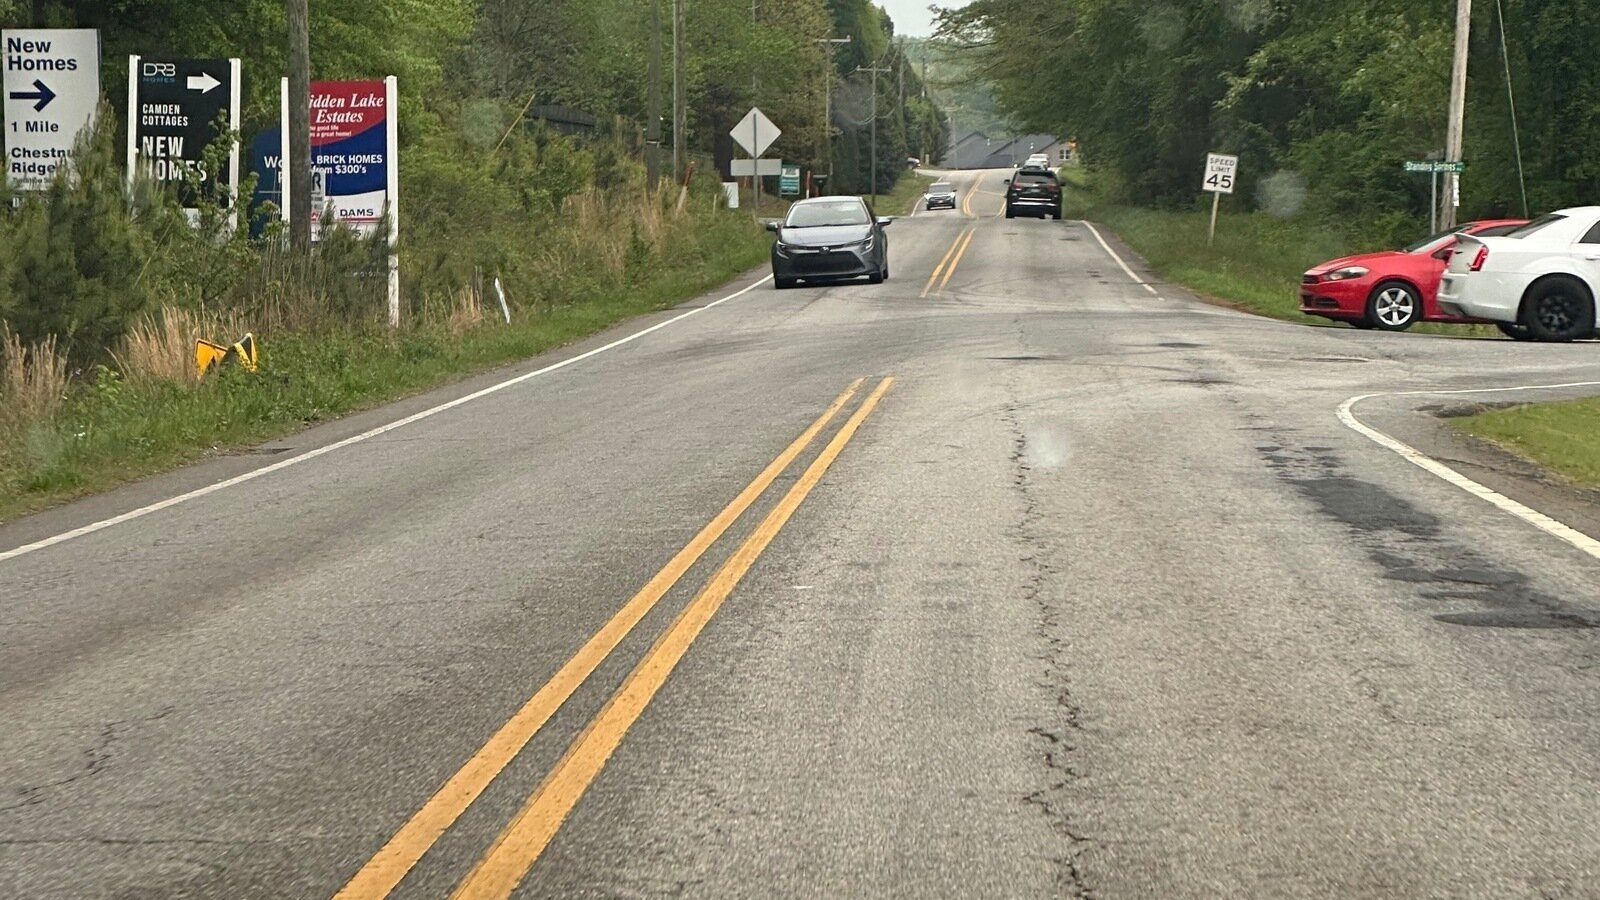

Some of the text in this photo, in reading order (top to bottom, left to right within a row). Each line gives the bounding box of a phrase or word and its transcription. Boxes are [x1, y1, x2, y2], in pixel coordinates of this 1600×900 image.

[7, 37, 51, 53] New
[8, 55, 77, 71] Homes
[143, 63, 176, 76] DRB
[309, 93, 384, 108] idden Lake
[142, 104, 180, 115] CAMDEN
[316, 109, 364, 123] Estates
[11, 121, 59, 133] 1 Mile
[142, 115, 189, 127] COTTAGES
[11, 147, 78, 158] Chestnu
[142, 136, 184, 157] NEW
[316, 155, 346, 165] BRICK
[348, 154, 383, 164] HOMES
[1210, 157, 1235, 167] SPEED
[12, 162, 56, 175] Ridge
[334, 164, 367, 175] $300's
[1206, 173, 1232, 189] 45
